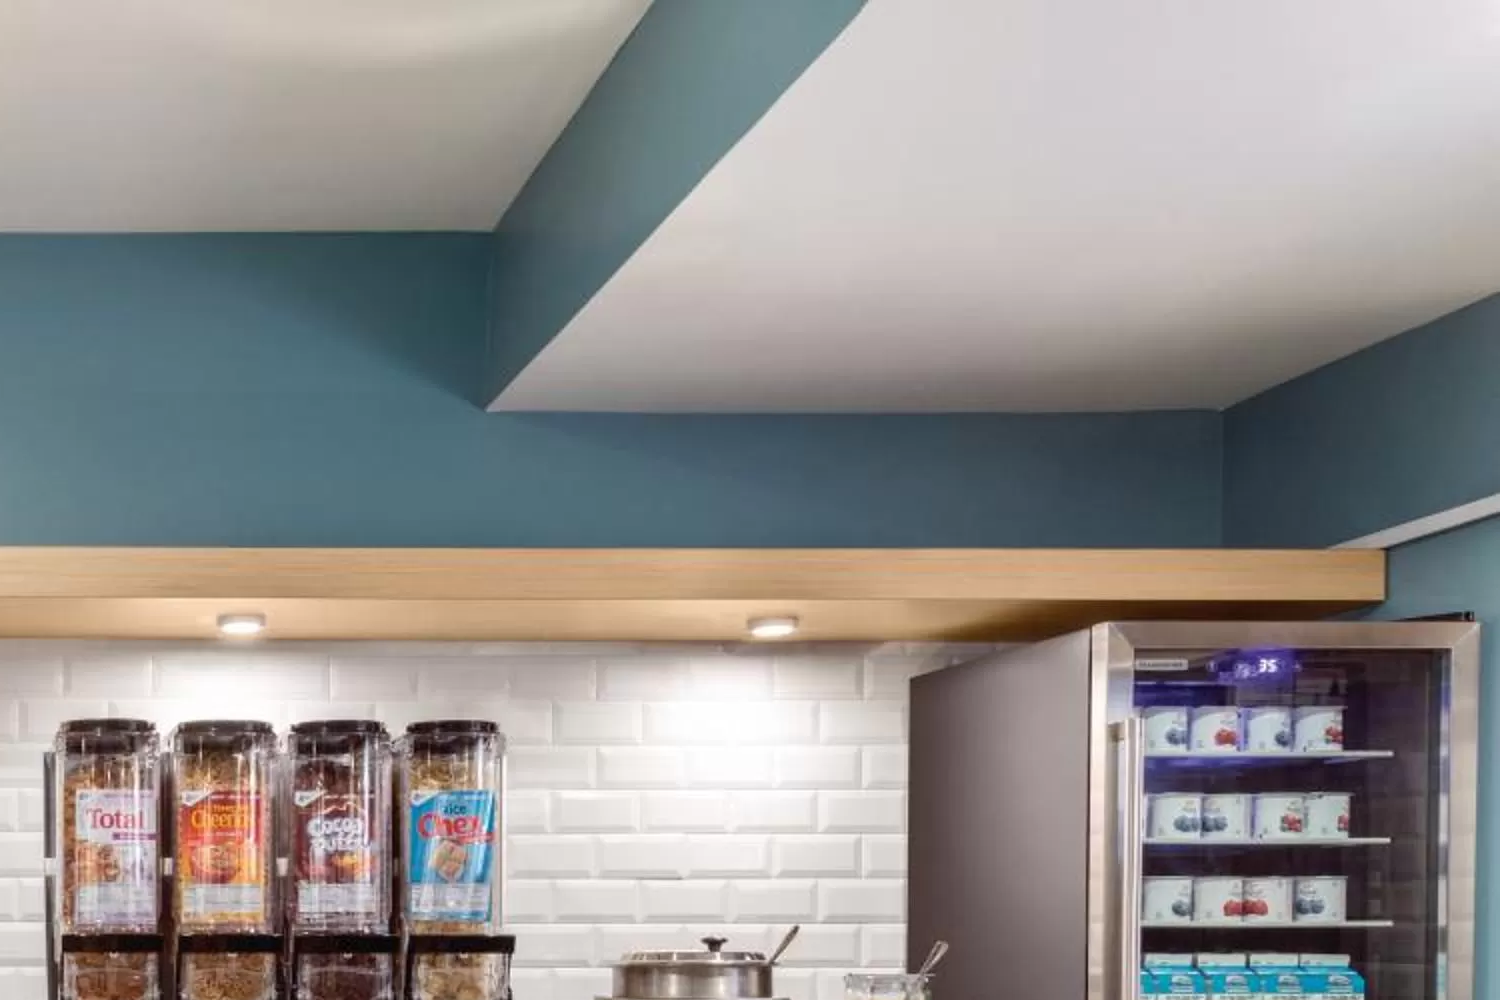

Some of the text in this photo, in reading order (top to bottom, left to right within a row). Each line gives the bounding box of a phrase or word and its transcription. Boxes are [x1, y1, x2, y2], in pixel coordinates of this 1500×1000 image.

[1259, 658, 1278, 673] 35
[86, 807, 144, 829] Total
[191, 809, 255, 829] Cheerio
[308, 818, 364, 838] Cocoa
